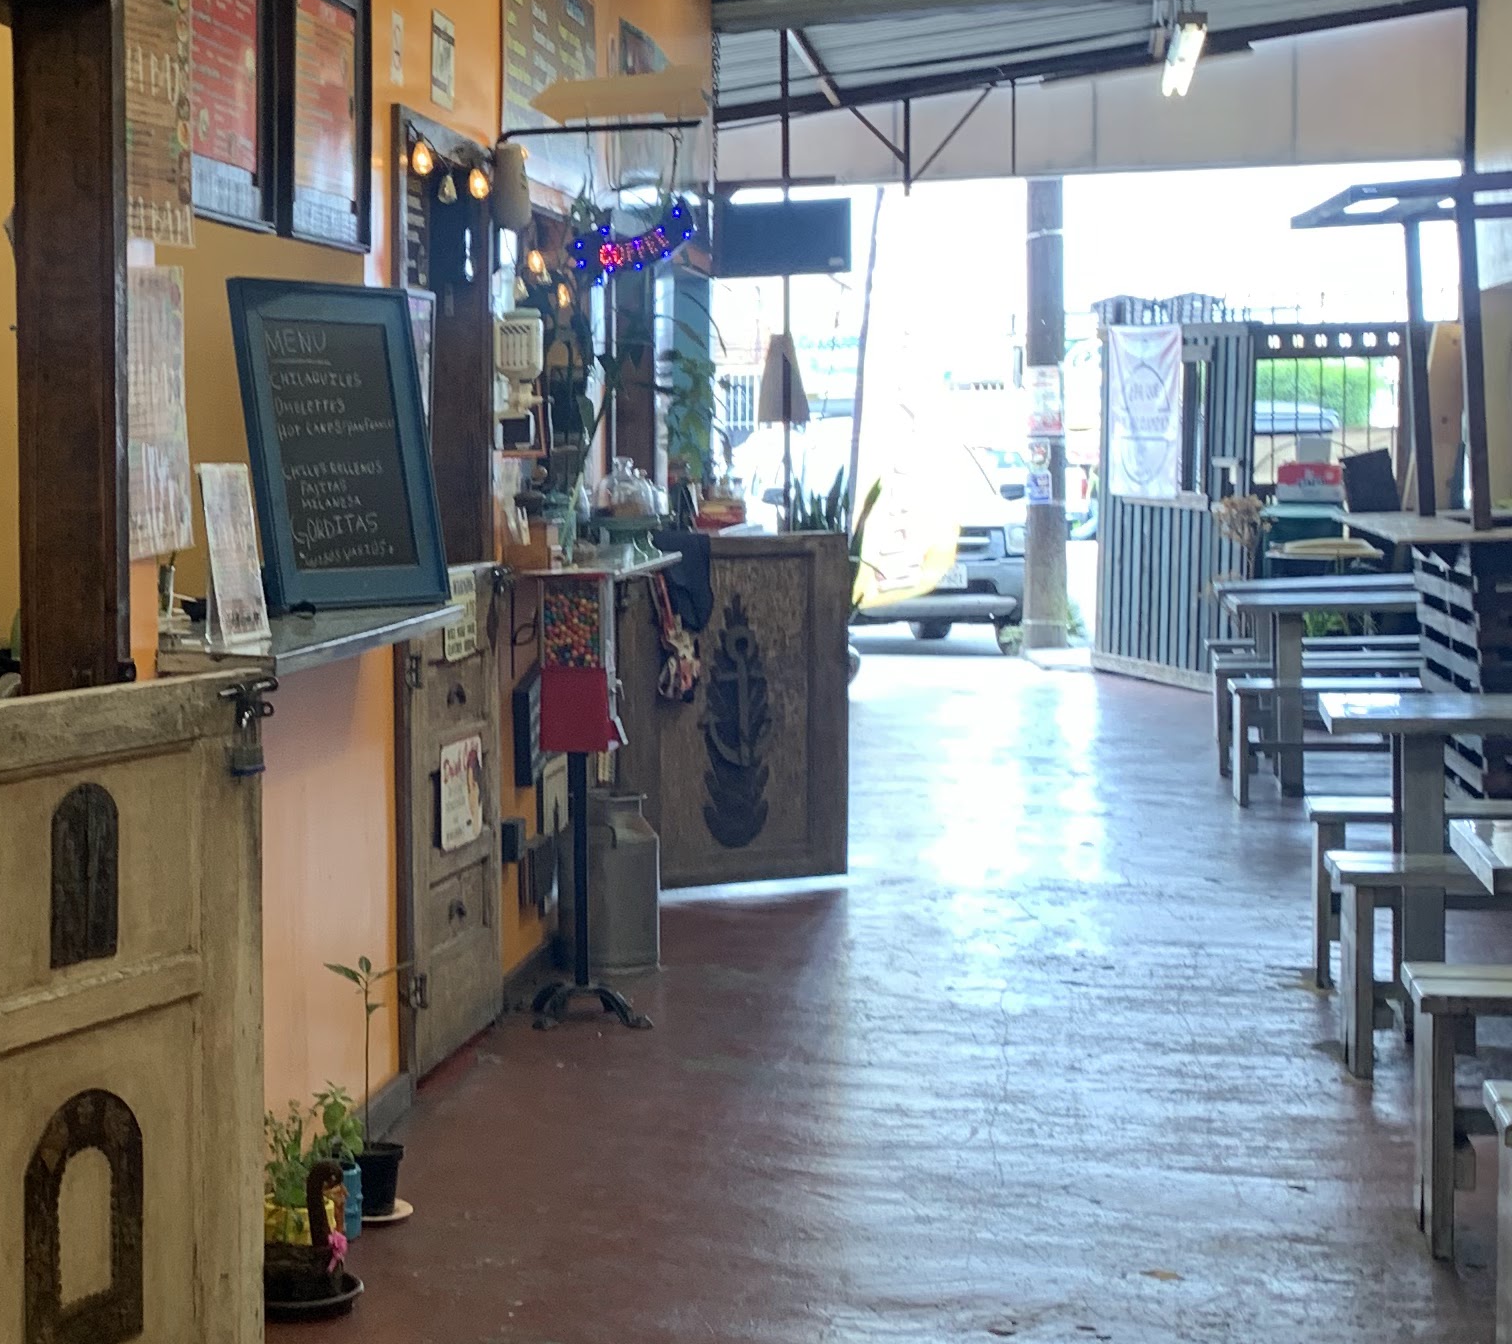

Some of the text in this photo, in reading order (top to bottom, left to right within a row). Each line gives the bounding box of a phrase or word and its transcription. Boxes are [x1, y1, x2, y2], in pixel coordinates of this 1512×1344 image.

[600, 229, 670, 267] COFFEE
[264, 328, 327, 356] MENU
[291, 512, 378, 550] GORDITAS
